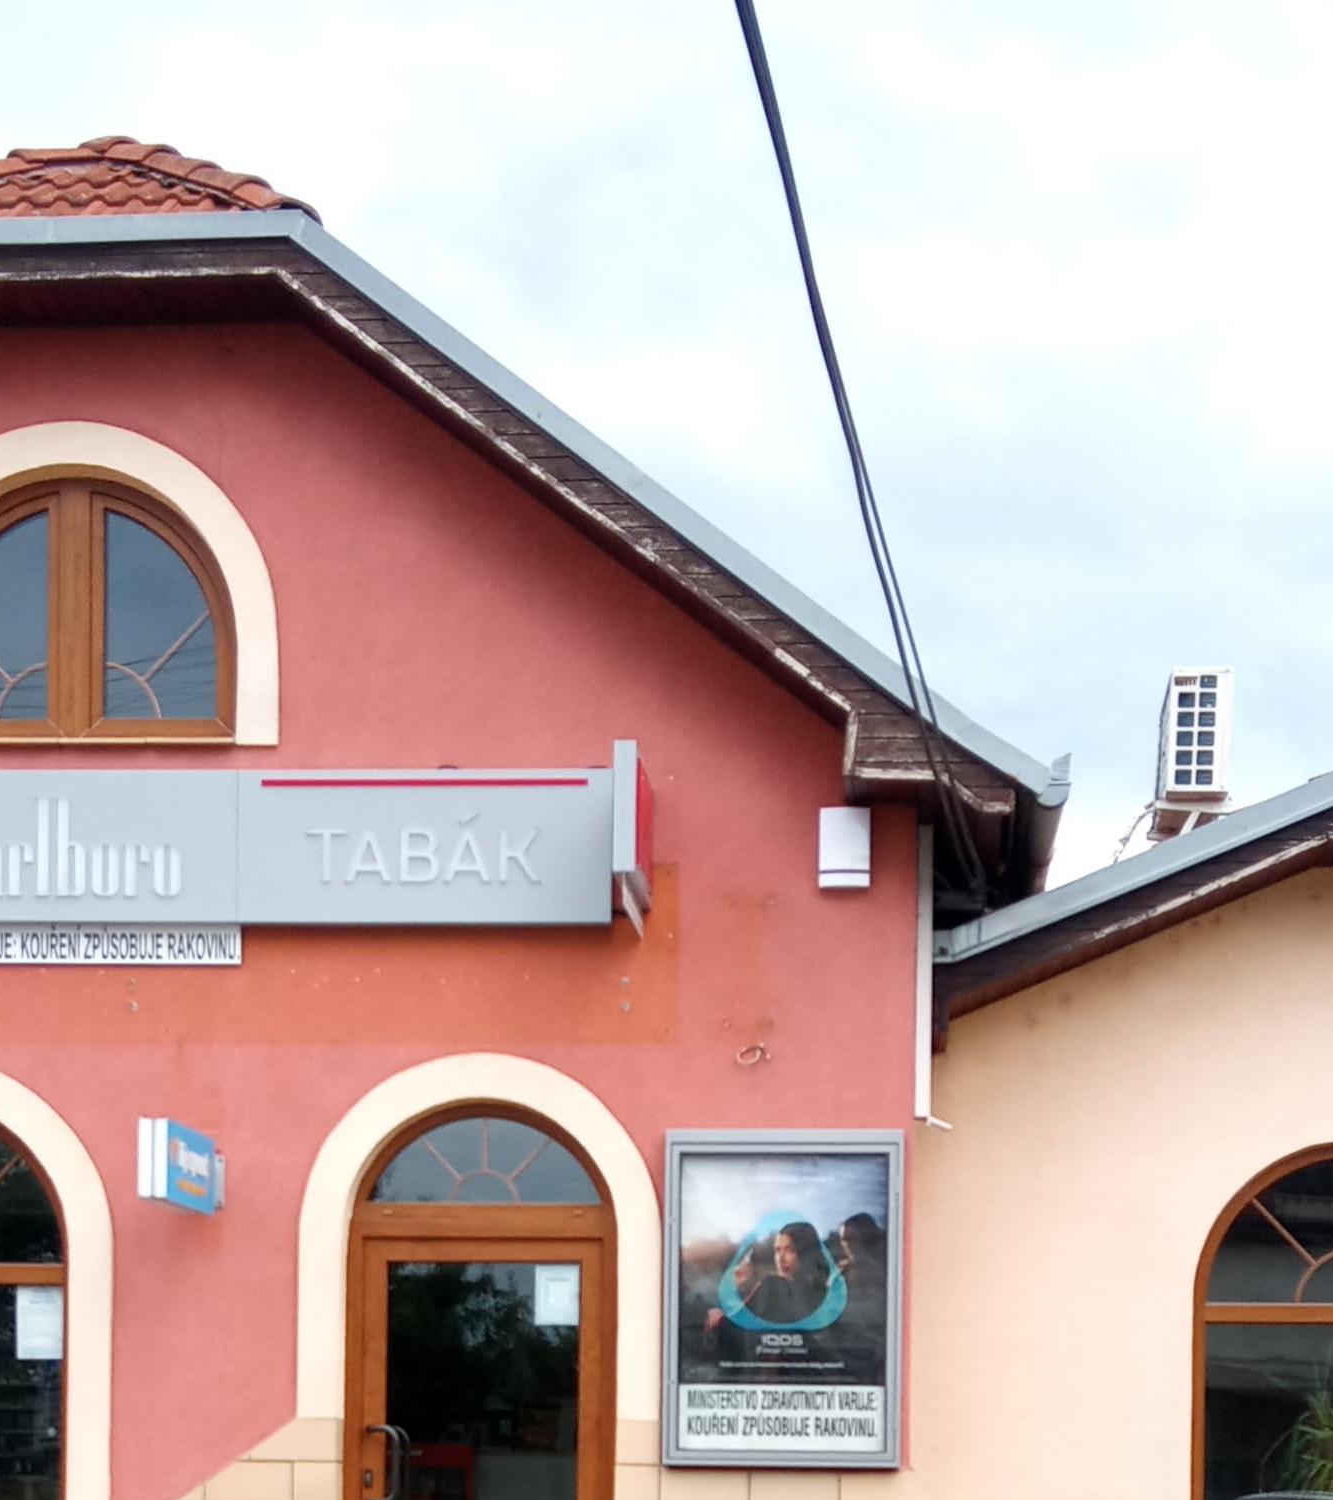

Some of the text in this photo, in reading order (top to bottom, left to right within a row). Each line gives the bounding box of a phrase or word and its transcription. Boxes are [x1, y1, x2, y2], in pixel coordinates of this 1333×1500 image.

[305, 811, 542, 886] TABÁK
[20, 924, 81, 960] KOUŘENÍ
[83, 925, 164, 961] ZPŮSOBUJE
[167, 931, 241, 961] RAKOVINU.
[687, 1390, 758, 1411] MINISTERSTVO
[687, 1412, 878, 1437] KOUŘENÍ ZPŮSOBUJE RAKOVINU.
